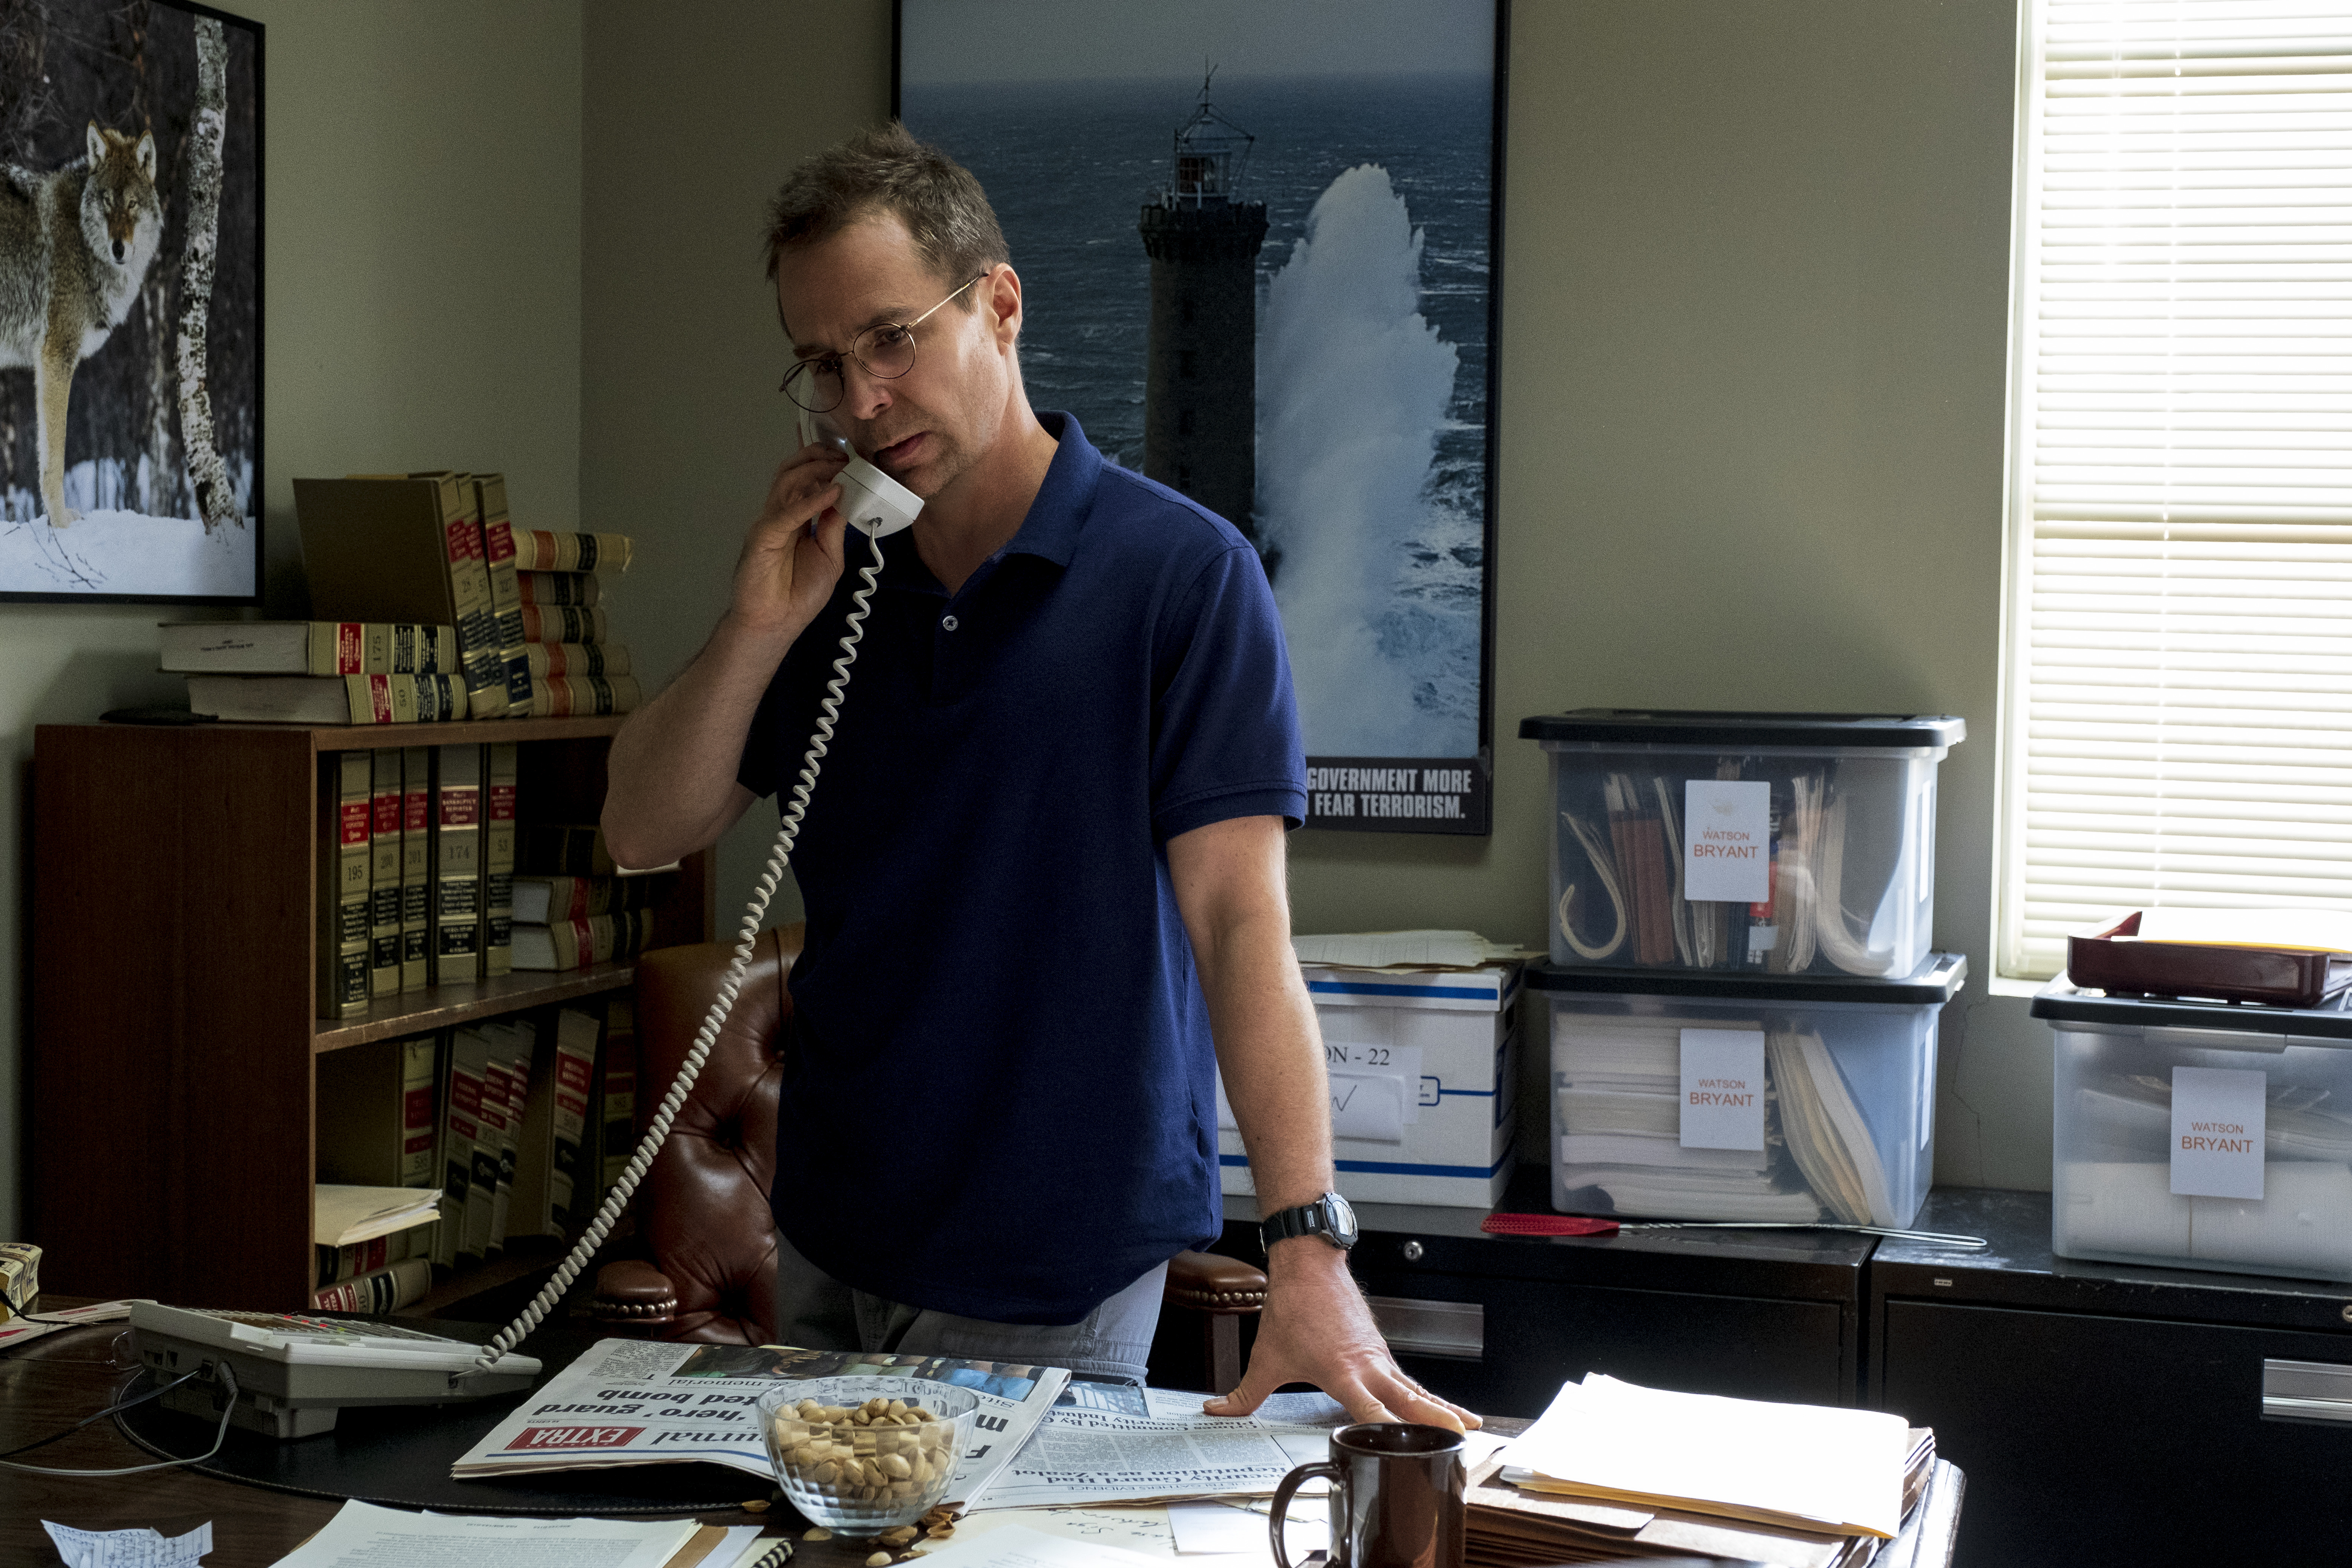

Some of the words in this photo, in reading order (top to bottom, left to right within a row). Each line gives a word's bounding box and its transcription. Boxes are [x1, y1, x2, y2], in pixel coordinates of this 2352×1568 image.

[373, 636, 381, 663] 175
[398, 689, 406, 707] 50
[1307, 767, 1418, 792] GOVERNMENT
[1423, 769, 1472, 793] MORE
[1315, 793, 1355, 816] FEAR
[1361, 794, 1465, 819] TERRORISM.
[1702, 831, 1750, 841] WATSON
[449, 845, 470, 859] 174
[1692, 844, 1759, 860] BRYANT
[348, 865, 363, 882] 195
[1368, 1048, 1390, 1065] 22
[1698, 1078, 1746, 1090] WATSON
[1689, 1092, 1754, 1108] BRYANT
[2191, 1121, 2244, 1134] WATSON
[2181, 1136, 2254, 1153] BRYANT
[668, 1379, 763, 1387] memorial
[596, 1390, 694, 1404] bomb
[532, 1403, 644, 1416] guard
[1089, 1421, 1188, 1431] Committed
[1113, 1416, 1187, 1427] Security
[529, 1427, 627, 1445] EXTRA
[965, 1445, 992, 1459] F
[1011, 1469, 1089, 1478] Zealot
[1151, 1467, 1286, 1476] Reputation
[1189, 1473, 1284, 1484] Security
[53, 1524, 102, 1538] PHONE
